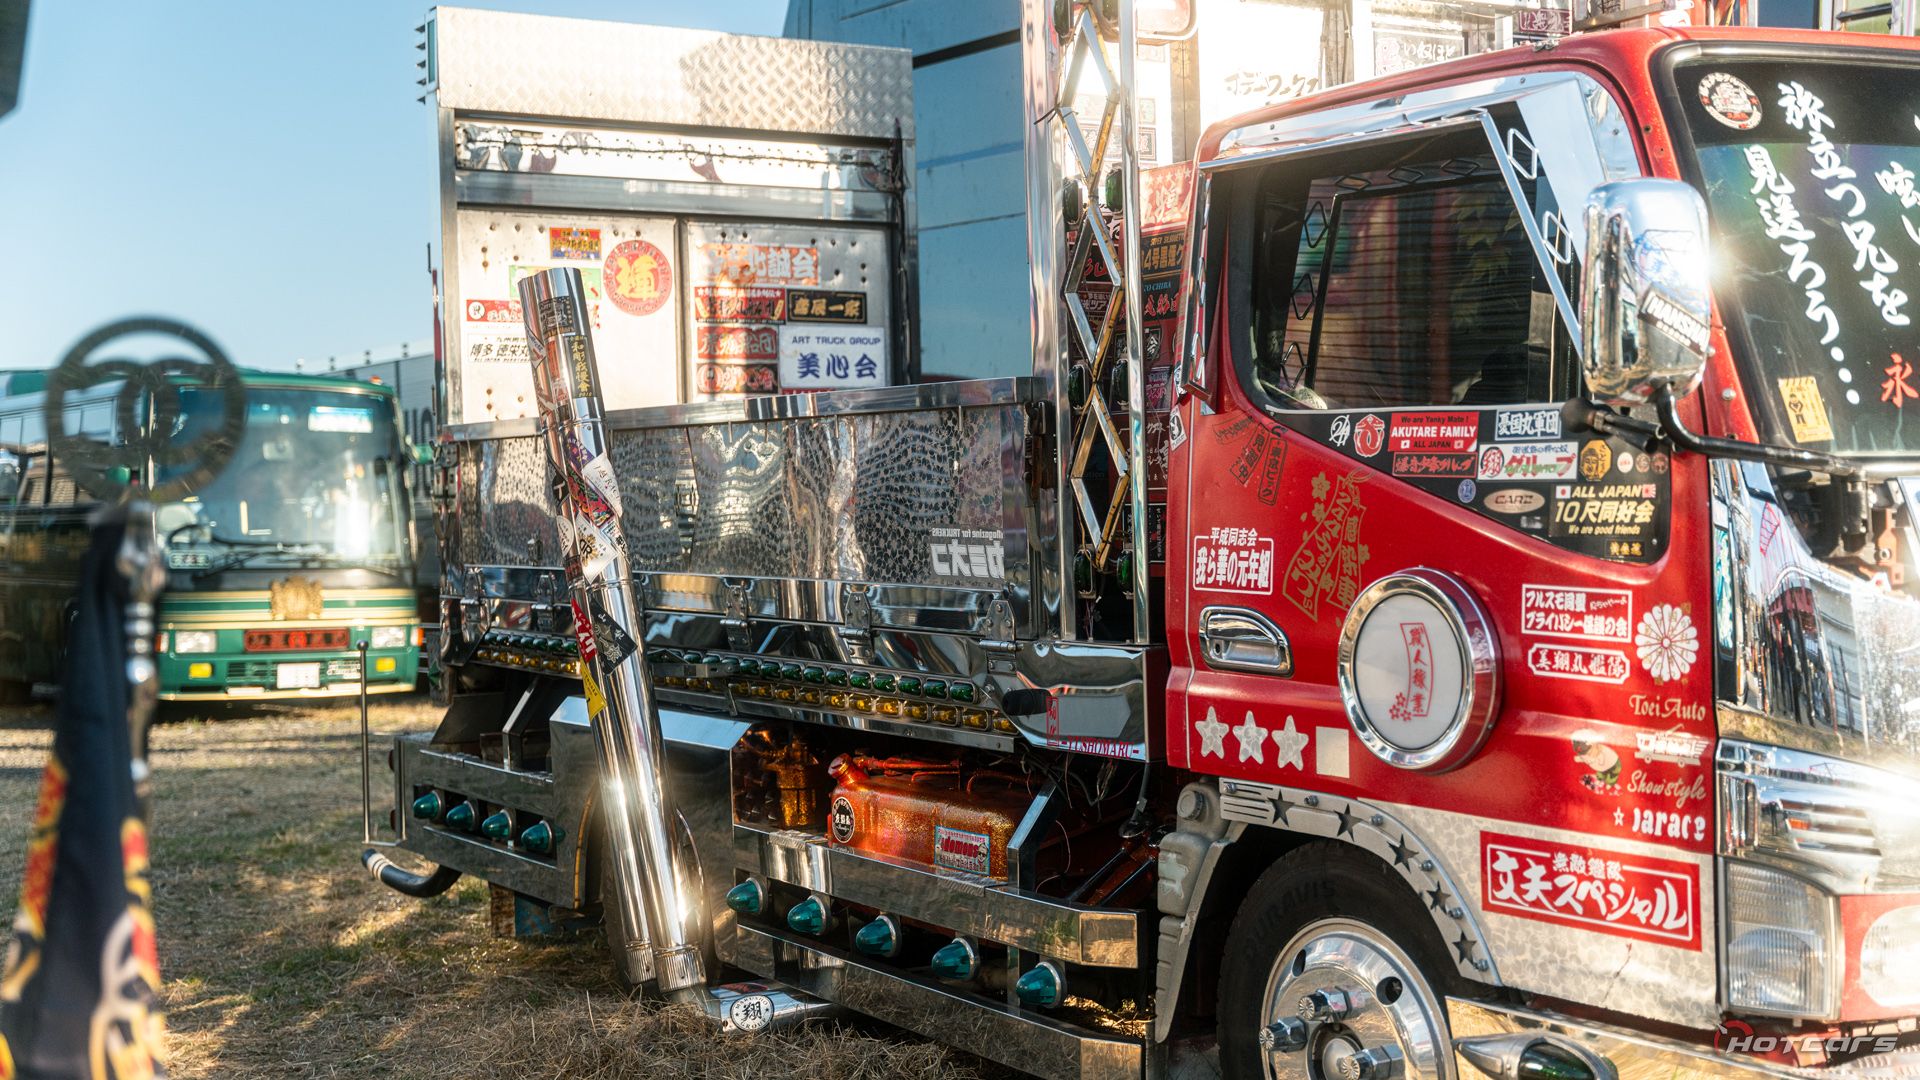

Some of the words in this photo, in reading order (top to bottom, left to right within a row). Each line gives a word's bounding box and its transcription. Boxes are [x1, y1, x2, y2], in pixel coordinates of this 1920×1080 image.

[792, 335, 811, 344] ART
[815, 336, 846, 345] TRUCK
[849, 337, 881, 346] GROUP
[797, 352, 878, 380] 美心会
[1391, 426, 1437, 437] AKUTARE
[1439, 426, 1476, 438] FAMILY
[1413, 440, 1426, 448] ALL
[1428, 440, 1451, 448] JAPAN
[1571, 485, 1596, 498] ALL
[1598, 484, 1643, 498] JAPAN
[1555, 499, 1655, 523] 10尺同好会
[1210, 527, 1258, 547] 平成同志会
[1568, 524, 1579, 535] We
[1580, 526, 1593, 535] are
[1594, 525, 1613, 536] good
[1615, 524, 1641, 535] friends
[1195, 546, 1271, 589] 我ら華の元年組
[1628, 694, 1661, 717] Toei
[1661, 697, 1706, 721] Auto
[742, 1001, 762, 1022] 翔
